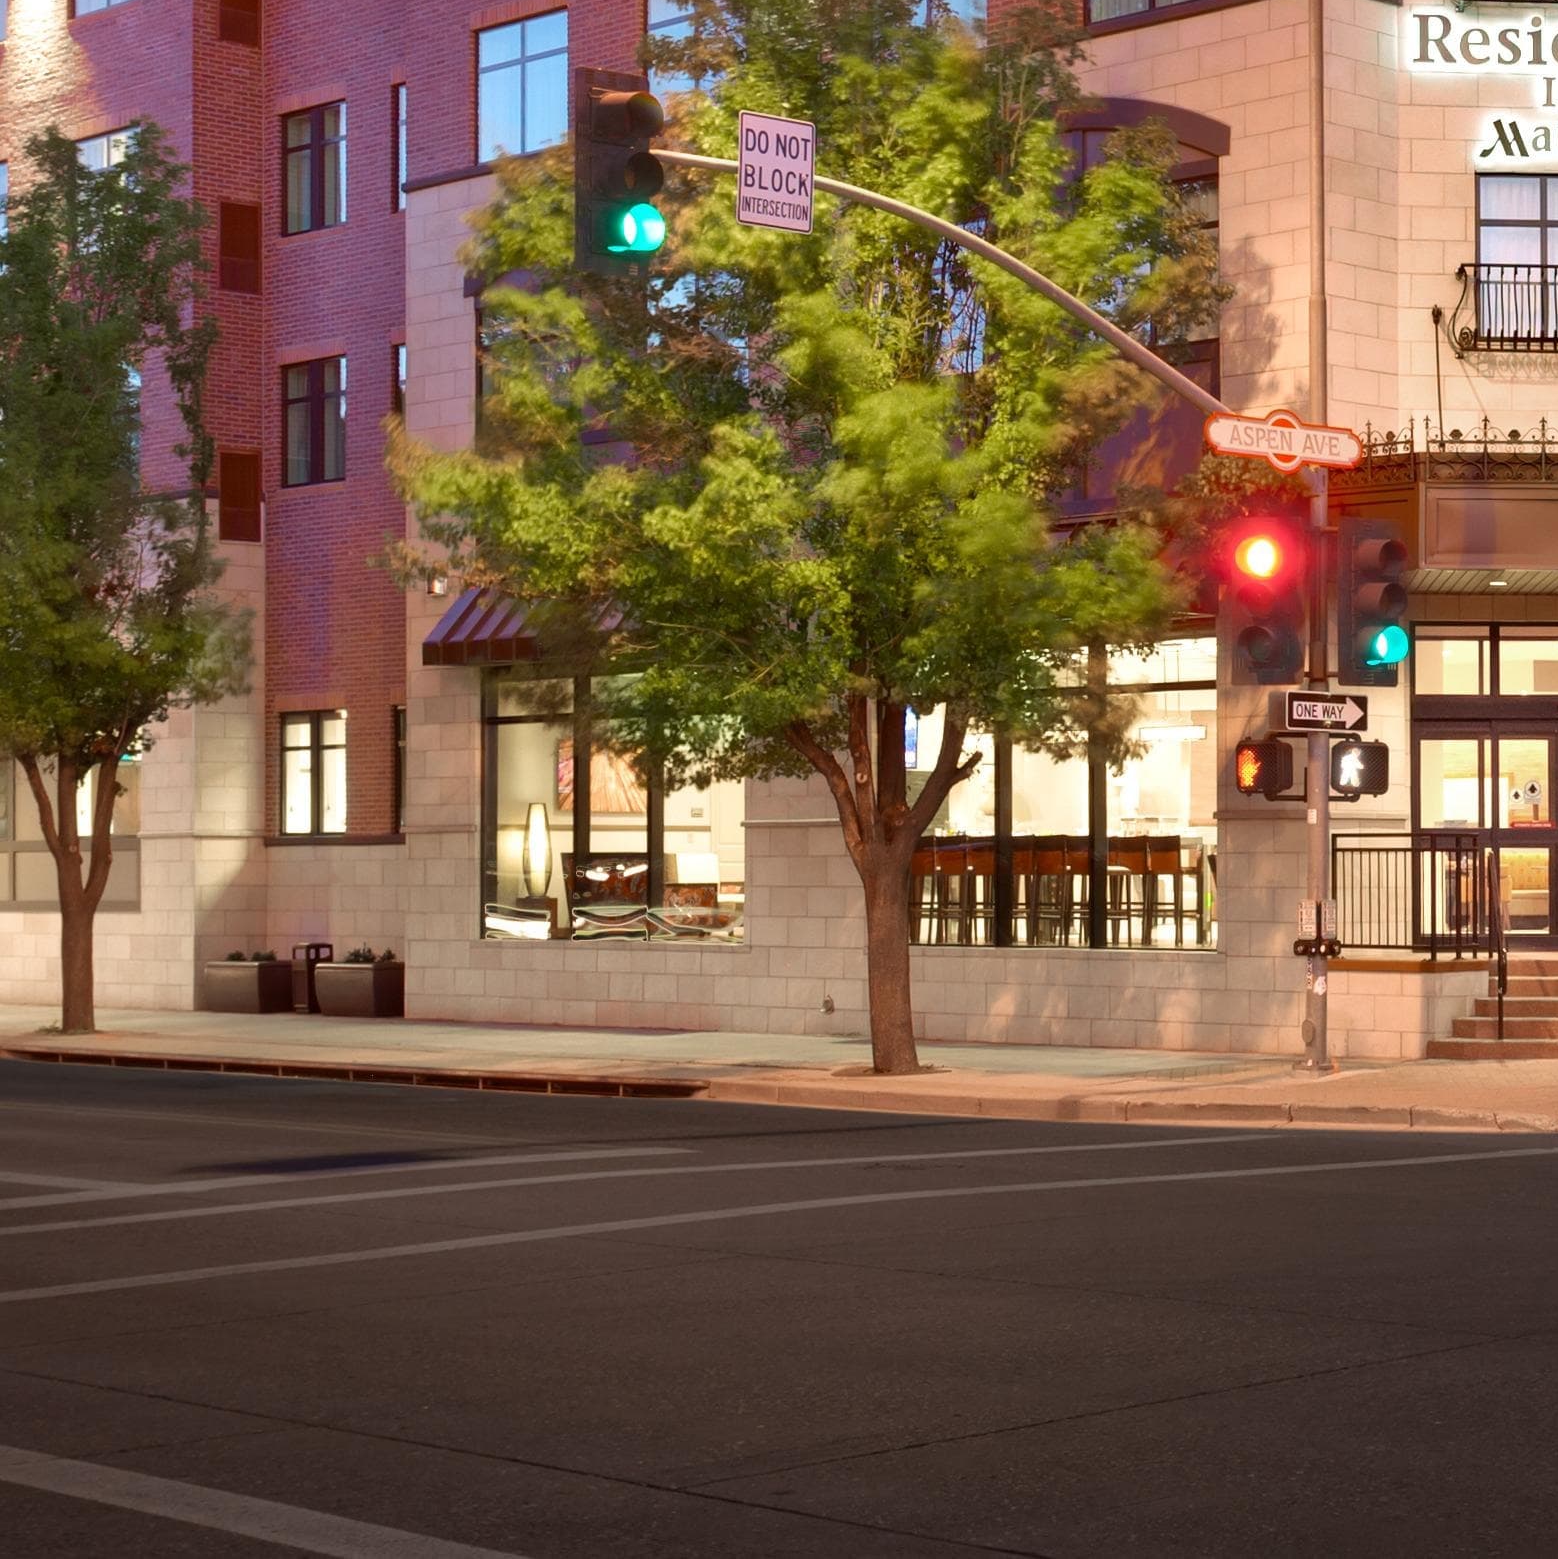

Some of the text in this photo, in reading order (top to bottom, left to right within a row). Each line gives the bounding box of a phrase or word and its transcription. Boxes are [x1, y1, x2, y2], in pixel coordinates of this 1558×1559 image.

[745, 128, 811, 161] DO NOT
[744, 164, 809, 197] BLOCK
[742, 195, 809, 221] INTERSECTION
[1229, 425, 1341, 456] ASPEN AVE
[1295, 703, 1344, 719] ONE WAY
